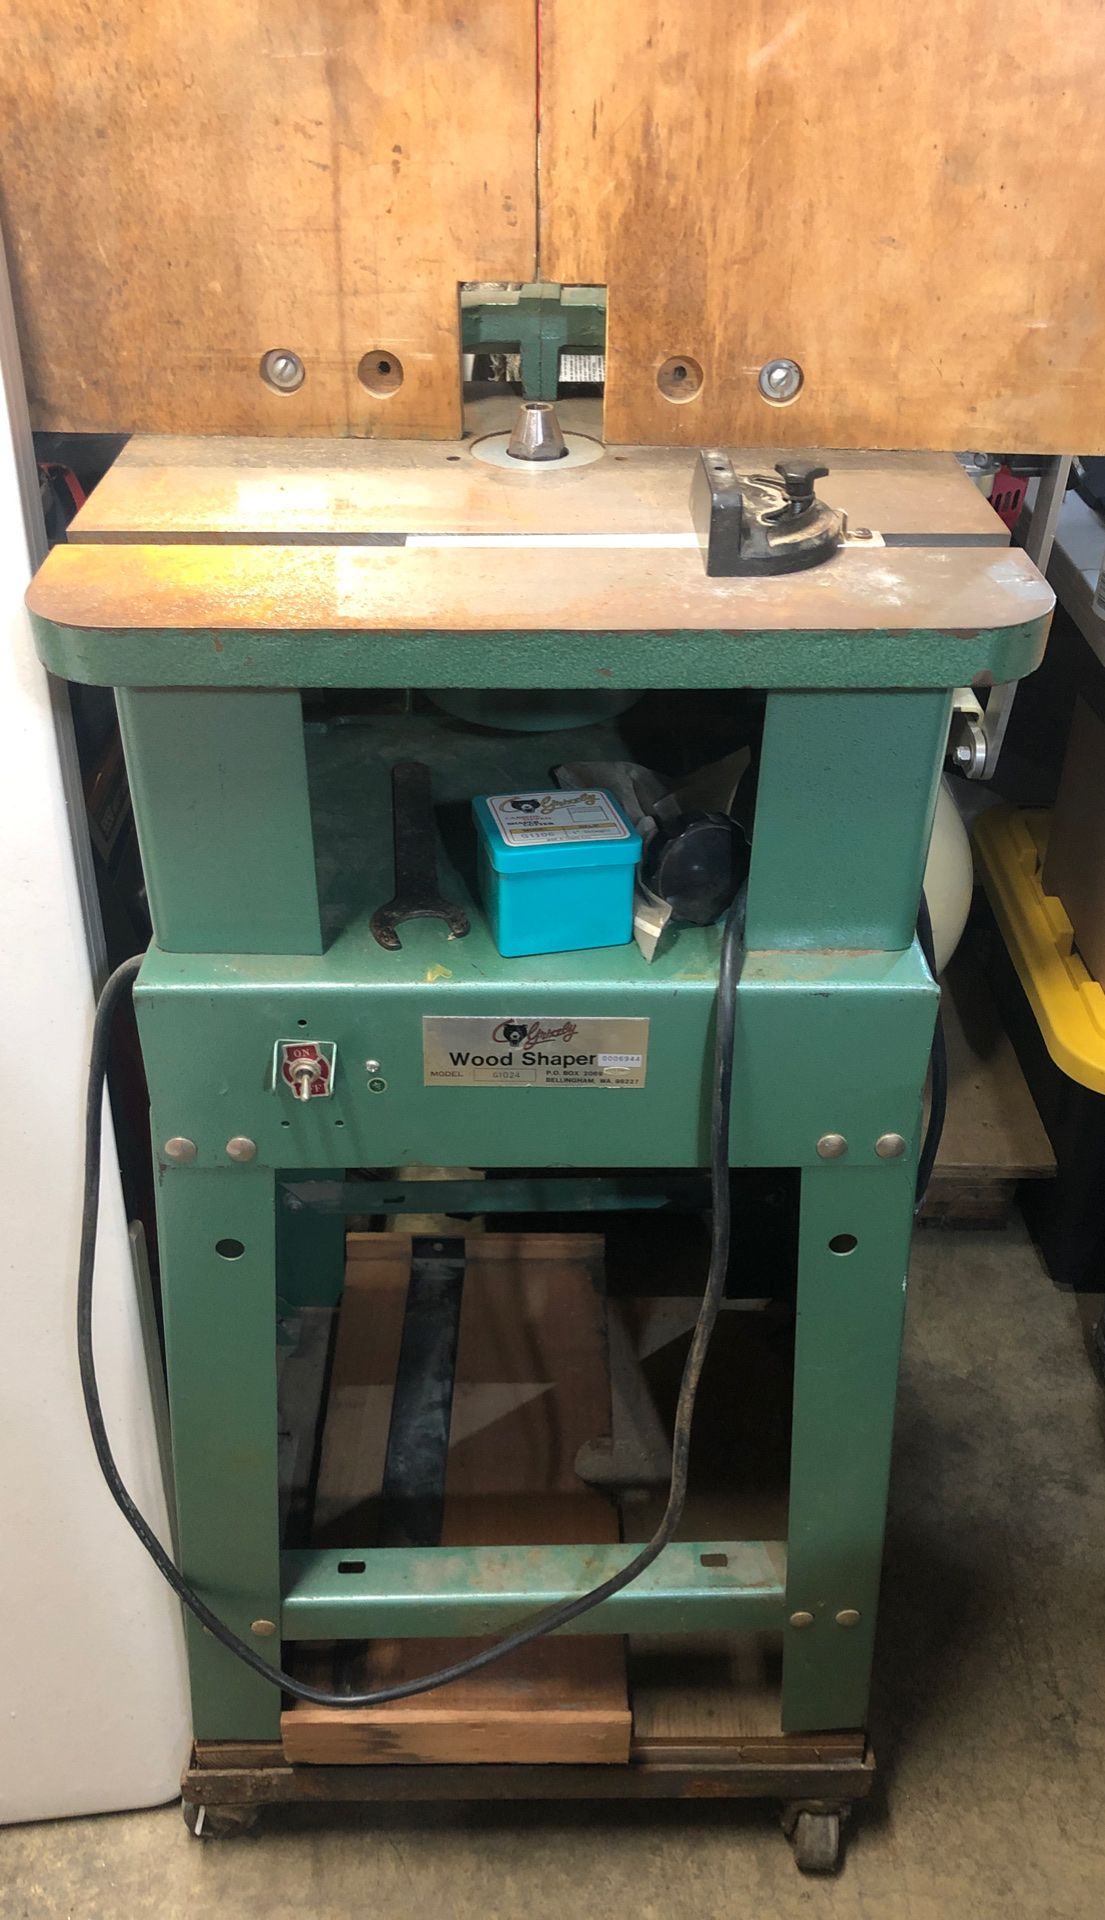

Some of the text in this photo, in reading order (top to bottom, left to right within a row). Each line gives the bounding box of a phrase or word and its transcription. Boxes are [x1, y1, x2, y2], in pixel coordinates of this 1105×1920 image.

[293, 1048, 311, 1058] ON
[449, 1052, 597, 1069] Wood Shaper
[430, 1070, 464, 1078] MODEL
